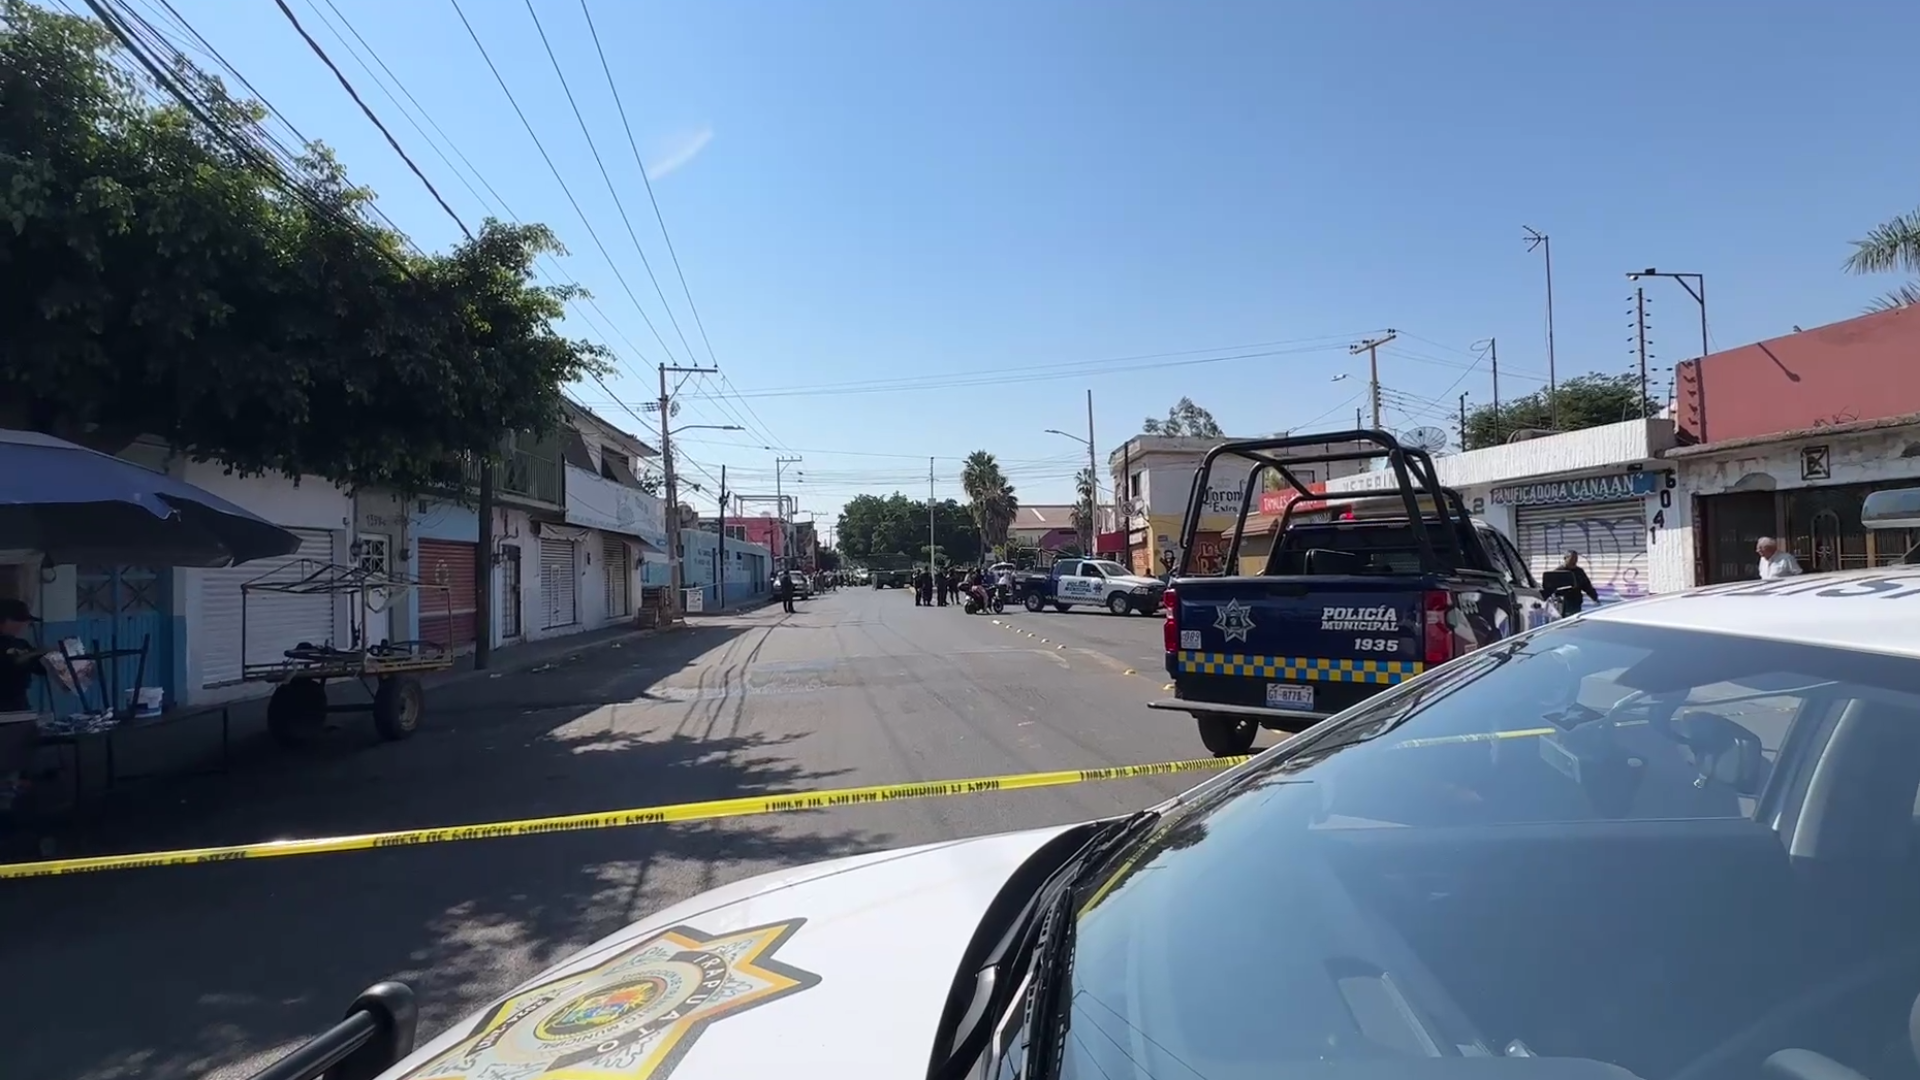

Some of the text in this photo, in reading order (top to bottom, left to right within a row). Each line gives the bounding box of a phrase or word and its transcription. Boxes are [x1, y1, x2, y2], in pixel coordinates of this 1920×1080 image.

[1203, 480, 1246, 506] Coron
[1492, 483, 1567, 503] PANIFICADORA
[1213, 501, 1238, 513] Extra
[1321, 604, 1397, 622] POLICÍA
[1321, 621, 1399, 632] MUNICIPAL
[1354, 638, 1399, 652] 1935
[595, 953, 722, 1054] IRAPUATO
